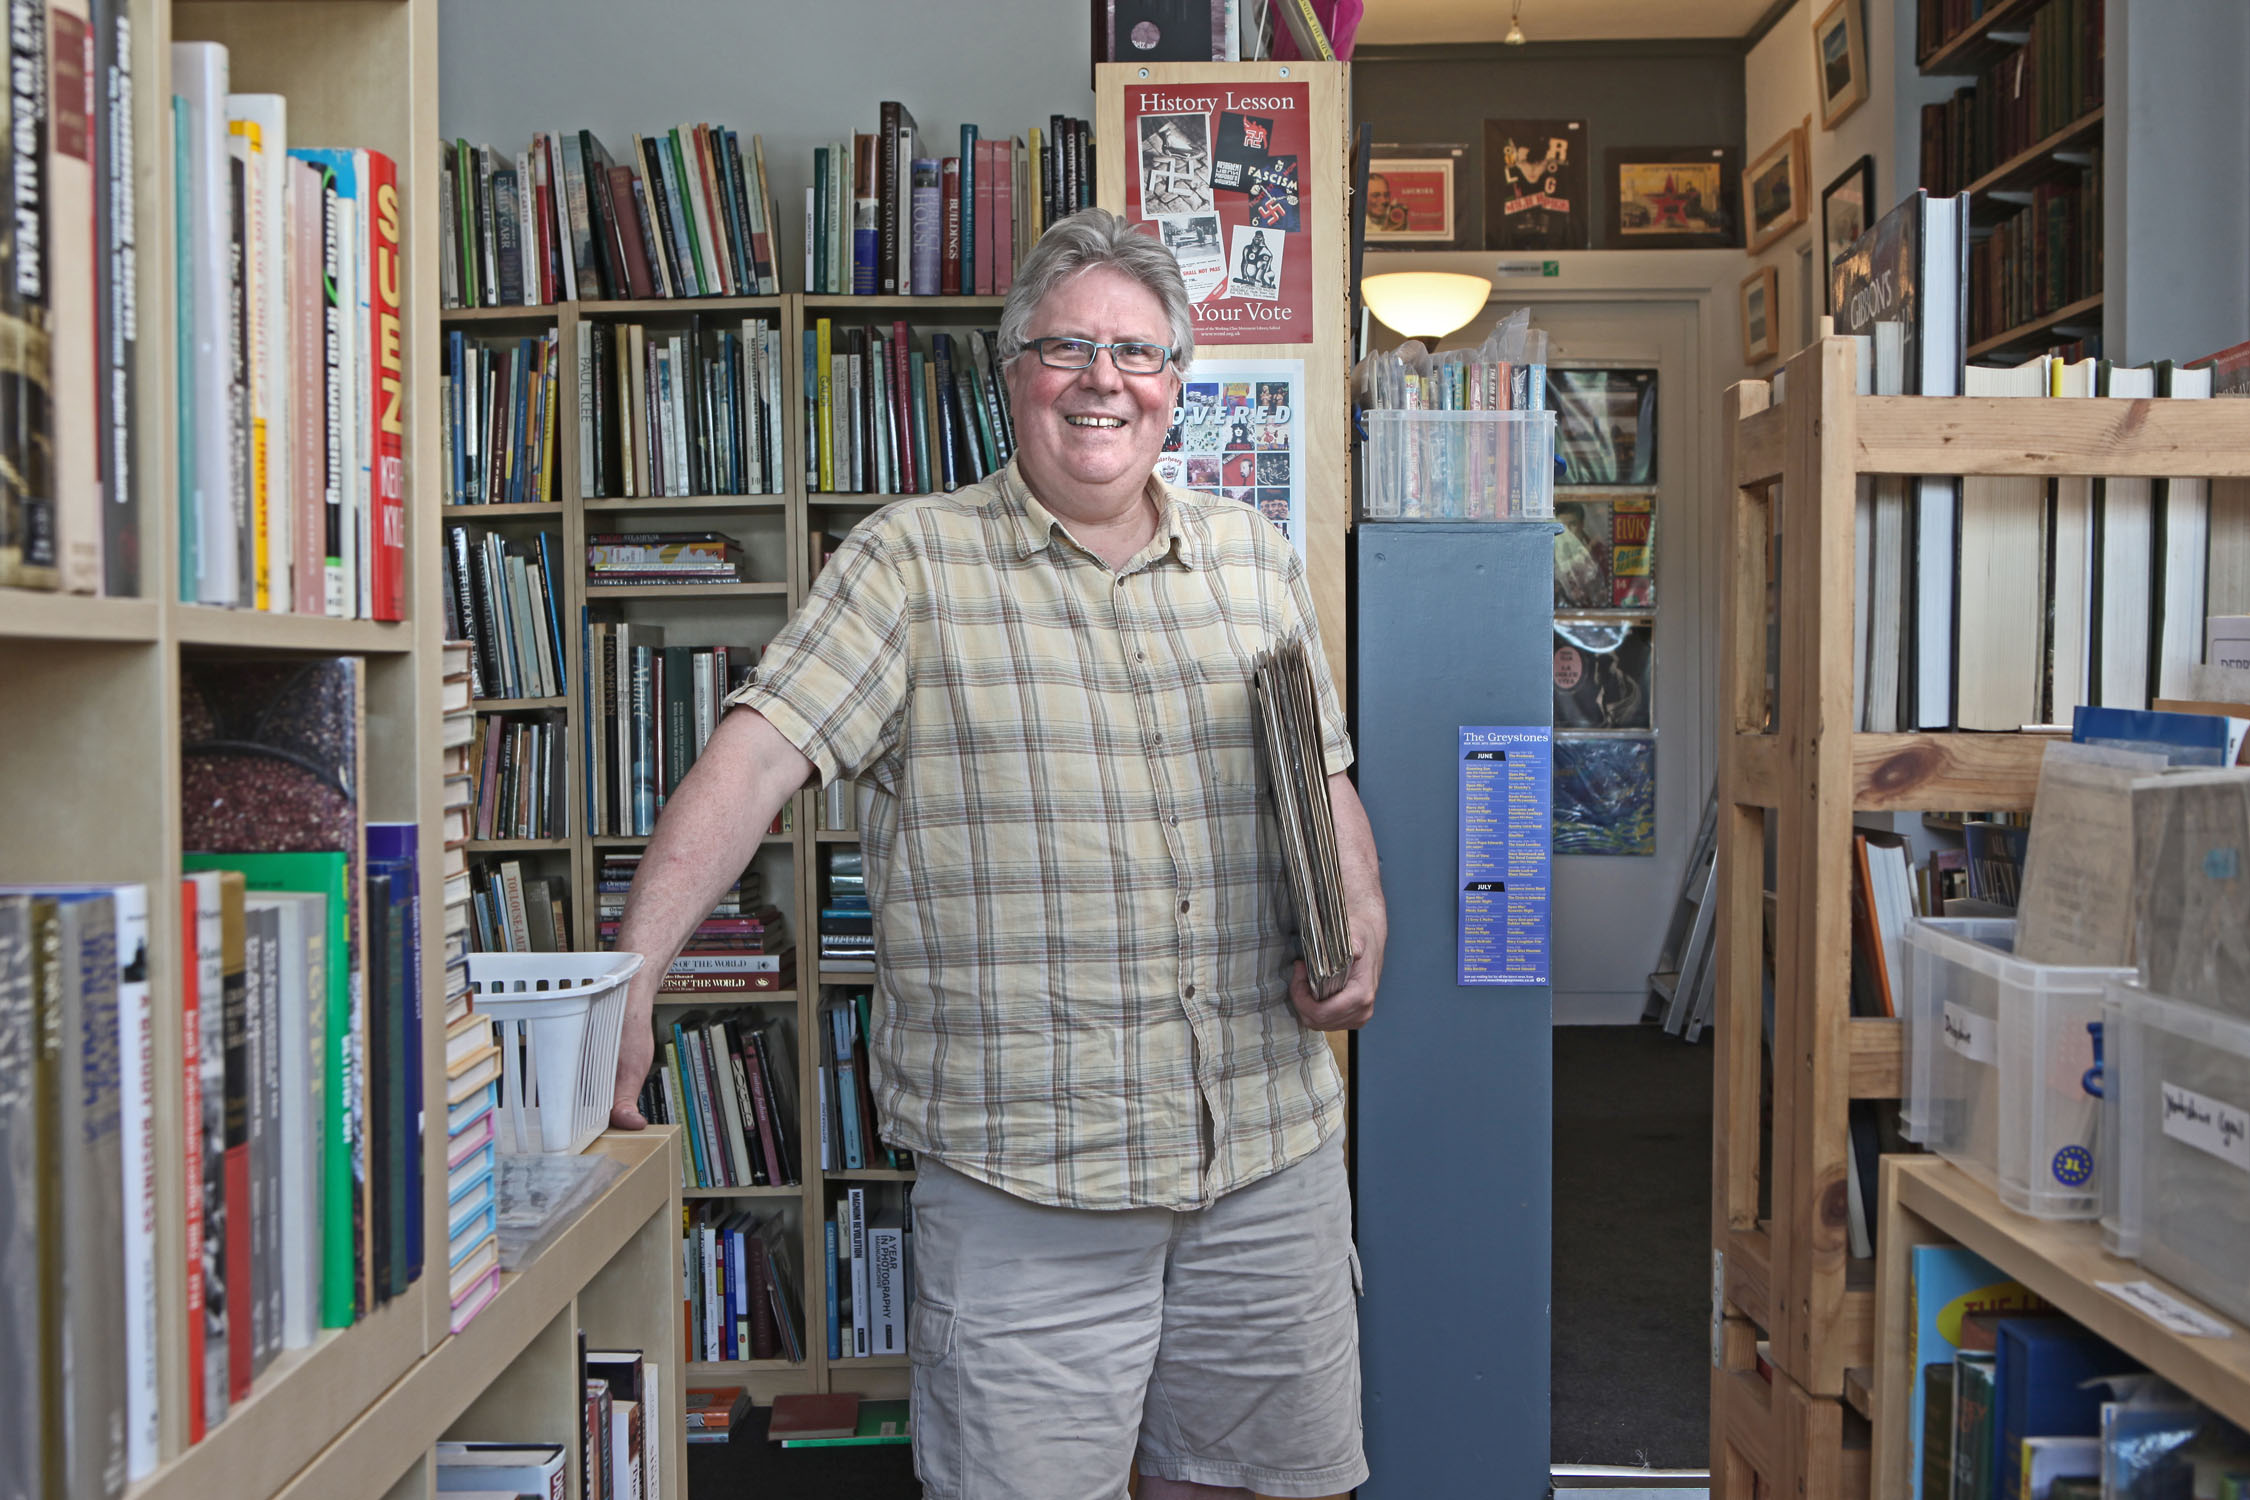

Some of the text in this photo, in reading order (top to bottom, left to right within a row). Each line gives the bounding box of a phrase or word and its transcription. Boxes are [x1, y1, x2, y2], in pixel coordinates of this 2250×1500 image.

[1140, 92, 1295, 114] History Lesson
[12, 56, 40, 296] TO END ALL PEACE
[1067, 133, 1076, 208] COUNTRY MANORS
[1079, 132, 1088, 182] Contemporary
[1248, 166, 1297, 190] FASCISM
[497, 176, 511, 248] EMILY CARR
[885, 116, 894, 261] ART NOUVEAU IN CATALONIA
[913, 193, 929, 253] HOUSE
[949, 198, 959, 259] BUILDINGS
[230, 243, 242, 282] The
[376, 184, 402, 436] SUEZ
[1192, 303, 1292, 321] Your Vote
[580, 357, 592, 423] PAUL KLEE
[1173, 406, 1291, 425] OVERED
[1616, 518, 1647, 539] ELVIS
[1464, 733, 1548, 744] The Greystones
[507, 876, 526, 952] TOULOUSE-LAUT
[713, 979, 745, 987] WORLD
[307, 934, 323, 1096] EGYPT
[732, 1059, 755, 1129] VOGUE
[853, 1190, 864, 1259] MAGNUM REVOLUTION
[881, 1235, 891, 1319] IN PHOTOGRAPHY
[889, 1244, 897, 1269] YEAR
